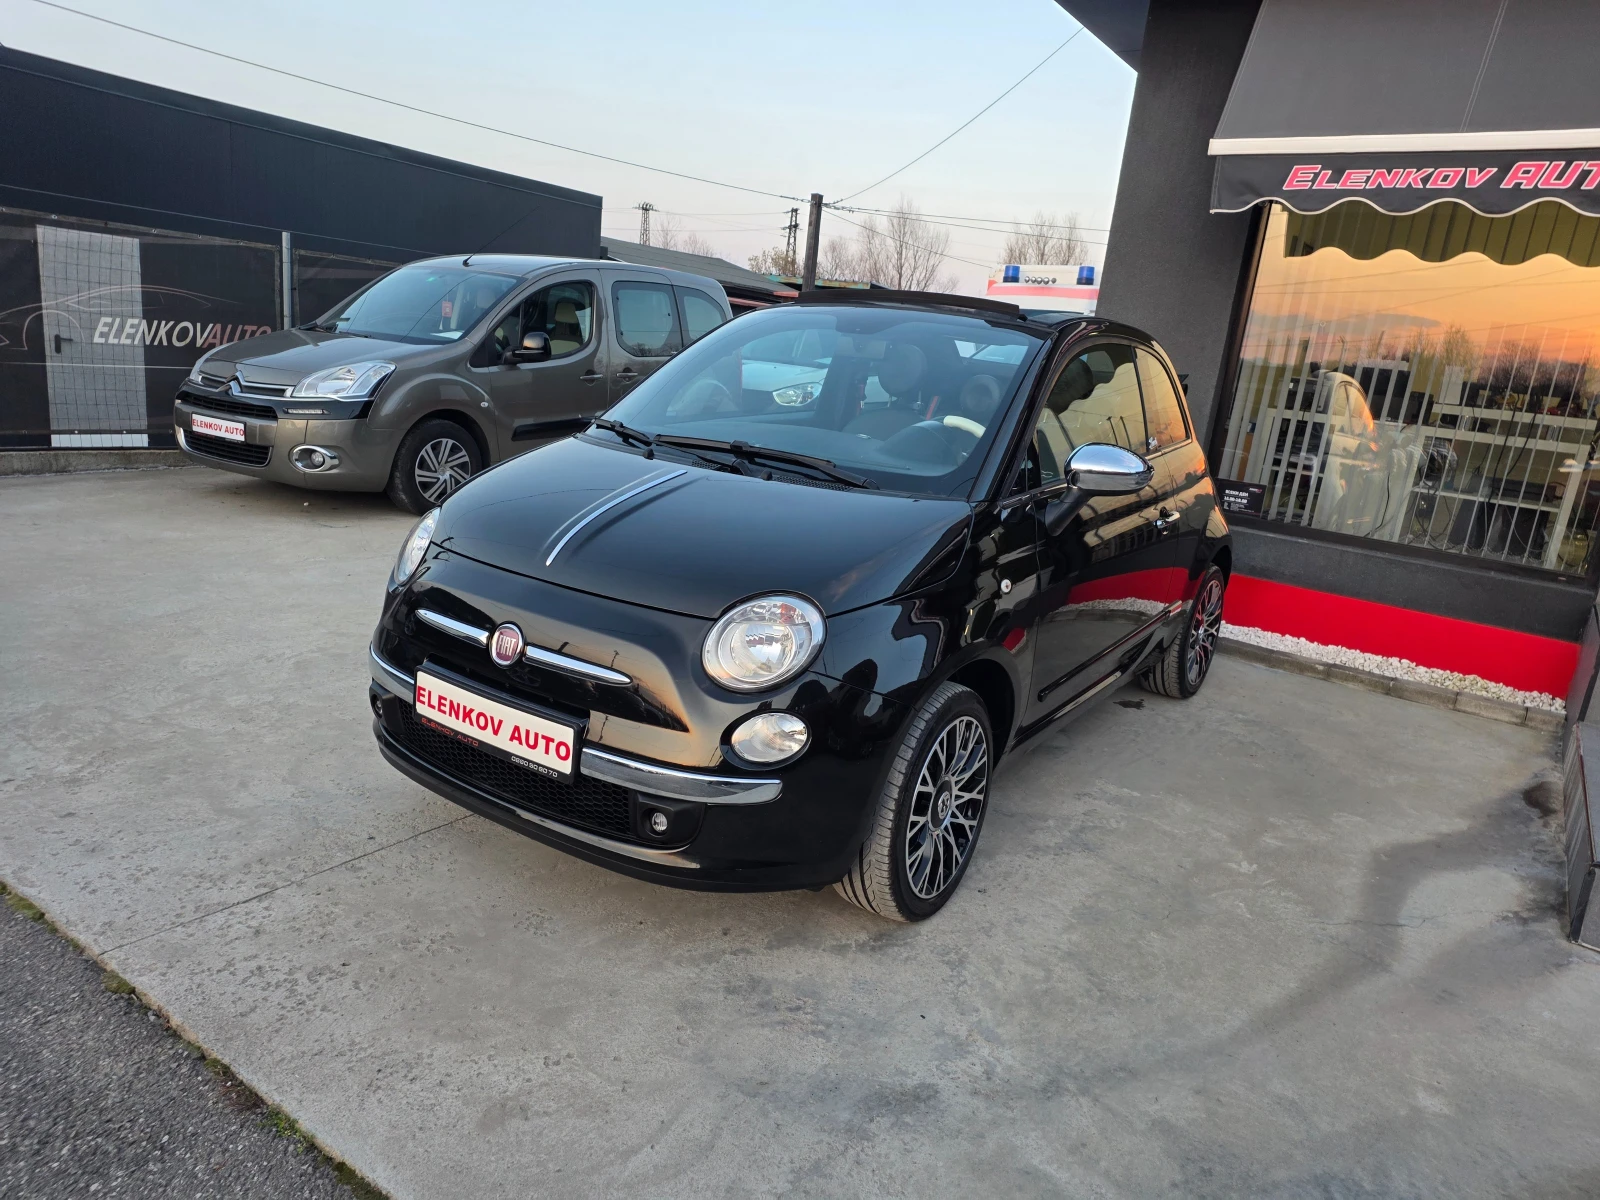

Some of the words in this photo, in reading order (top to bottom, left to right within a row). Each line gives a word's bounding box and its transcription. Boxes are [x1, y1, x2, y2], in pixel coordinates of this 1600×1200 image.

[192, 418, 223, 432] ELENKOV
[224, 425, 245, 437] AUTO
[496, 633, 517, 657] FIAT
[416, 685, 503, 737] ELENKOV
[508, 725, 571, 762] AUTO
[456, 734, 479, 747] AUTO
